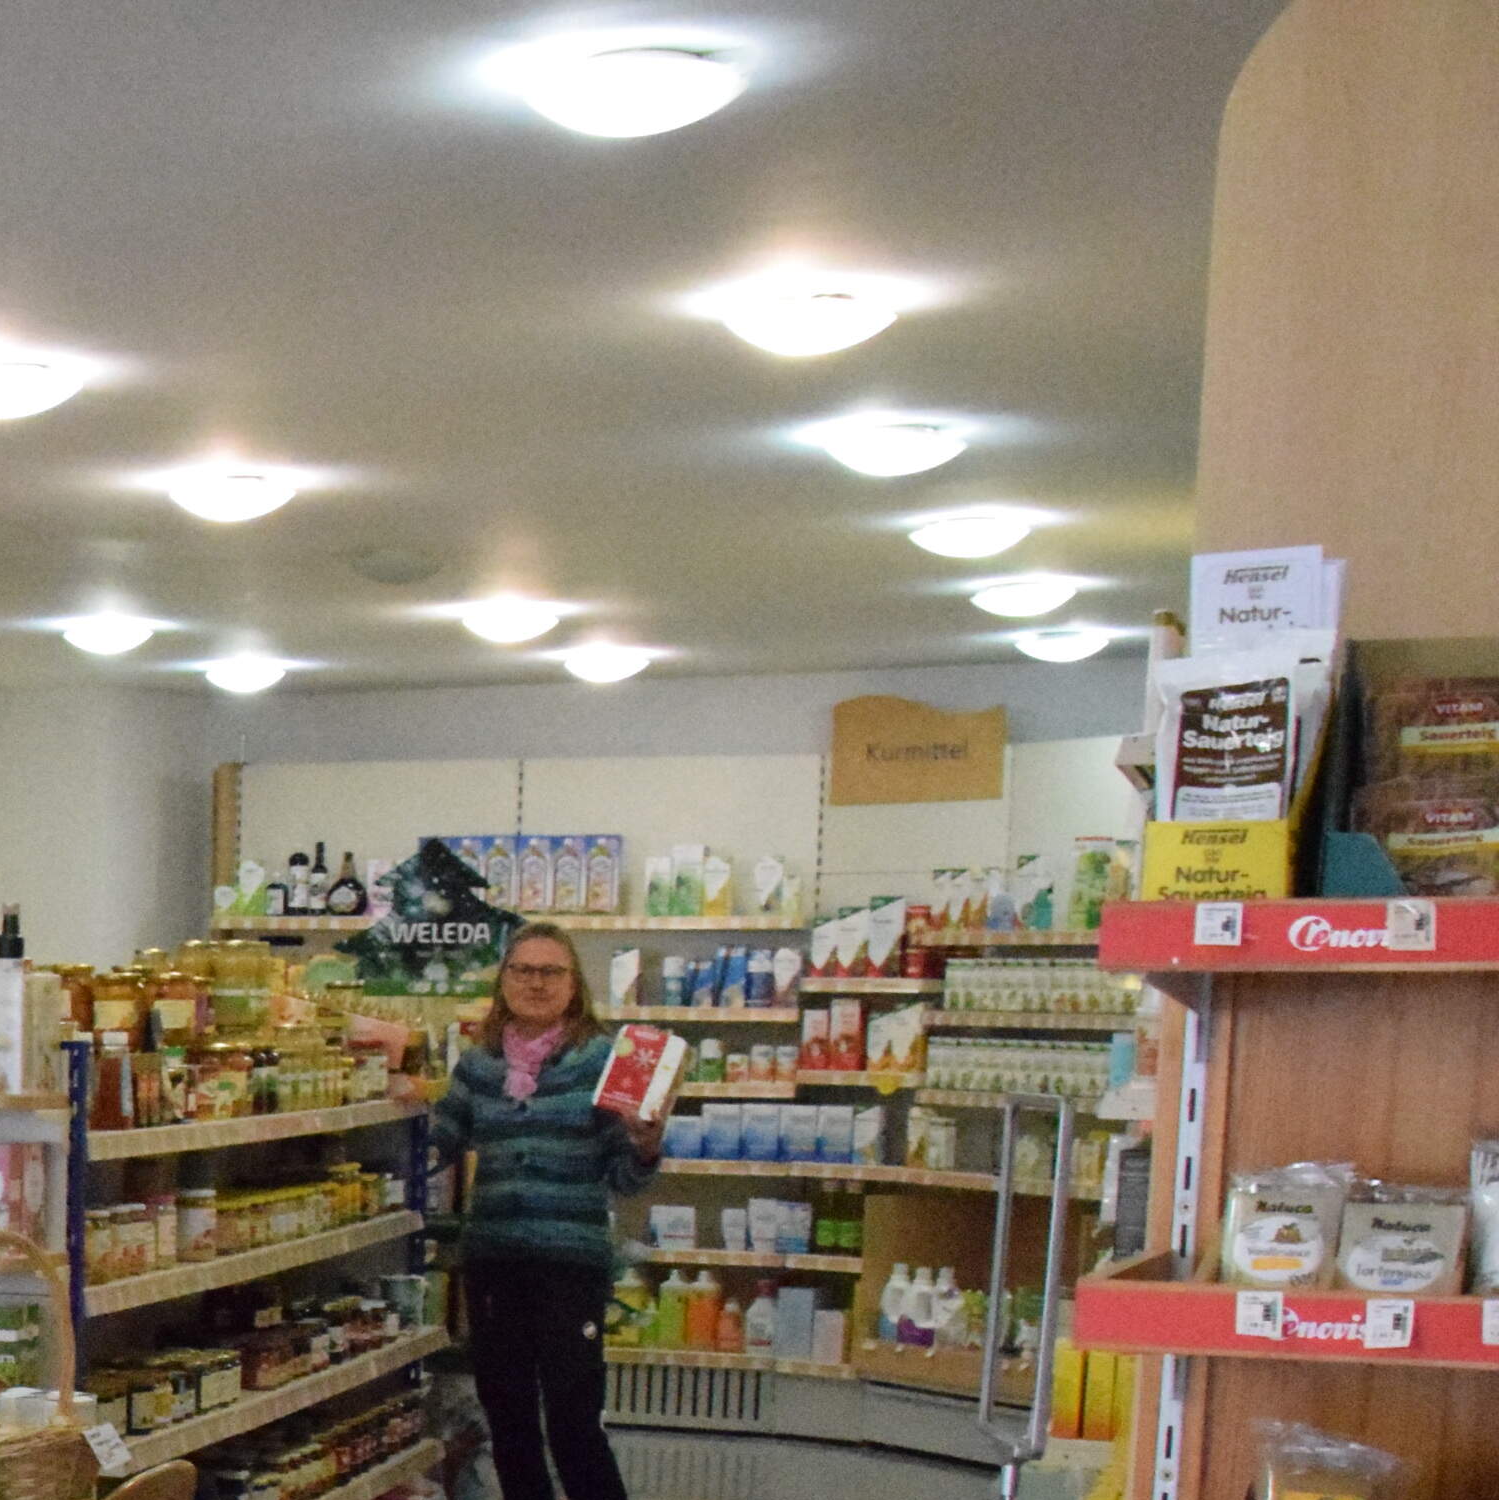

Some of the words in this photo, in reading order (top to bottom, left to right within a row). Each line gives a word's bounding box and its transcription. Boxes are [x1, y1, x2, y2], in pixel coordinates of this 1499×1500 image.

[1223, 566, 1290, 585] Hensel
[1219, 606, 1291, 624] Natur-
[1203, 714, 1269, 733] Natur-
[1182, 728, 1285, 751] Sauerteig
[1181, 828, 1249, 846] Hensel
[1174, 865, 1250, 885] Natur-
[390, 922, 492, 945] WELEDA
